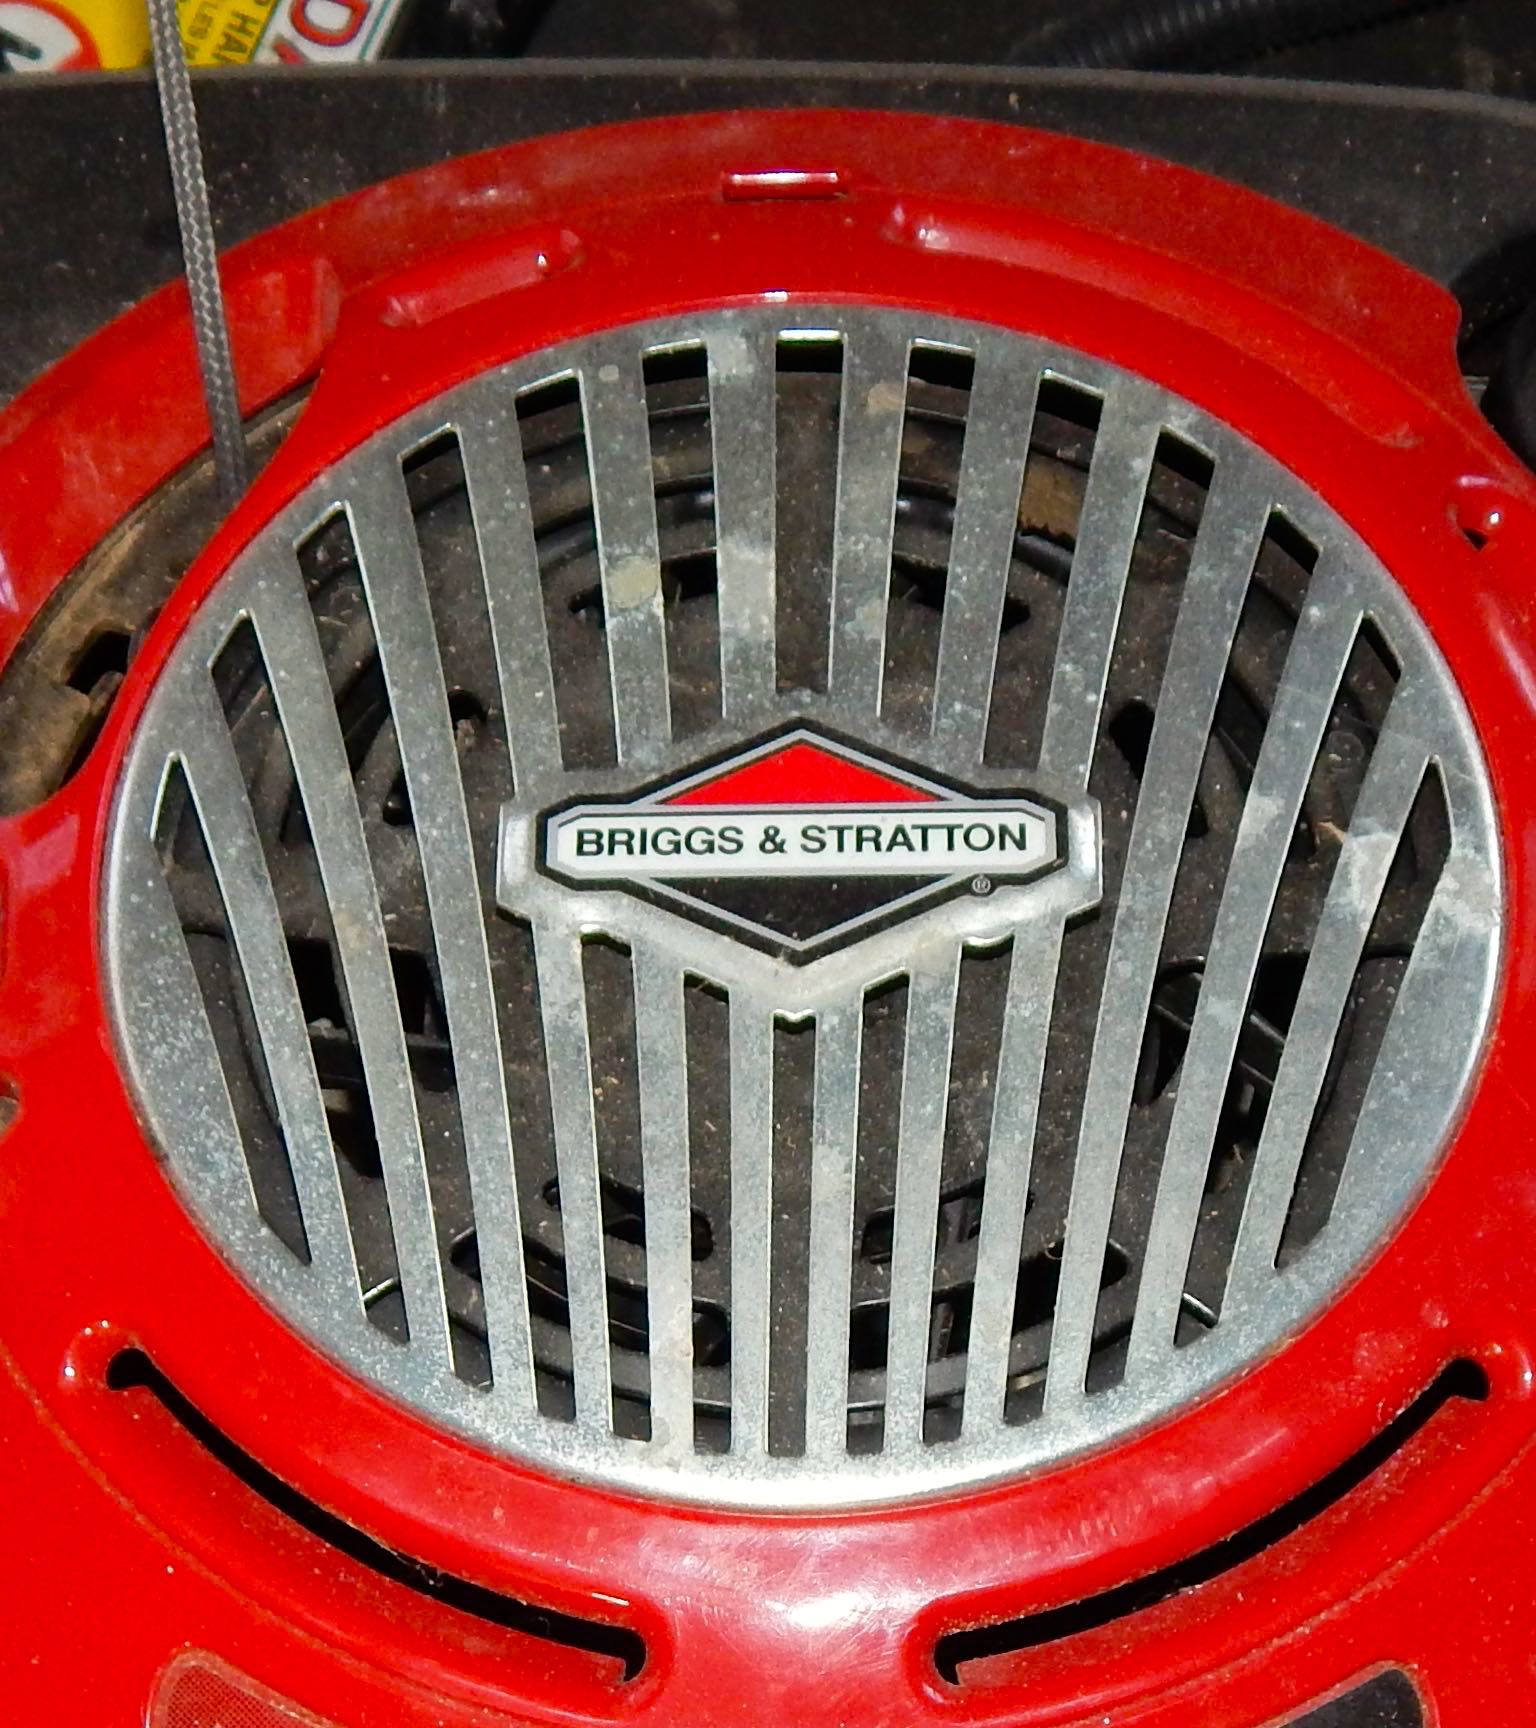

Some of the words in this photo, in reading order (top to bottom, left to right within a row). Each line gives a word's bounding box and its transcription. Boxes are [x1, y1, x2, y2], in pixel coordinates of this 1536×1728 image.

[575, 826, 745, 857] BRIGGS
[759, 826, 787, 854] &
[799, 822, 1028, 854] STRATTON
